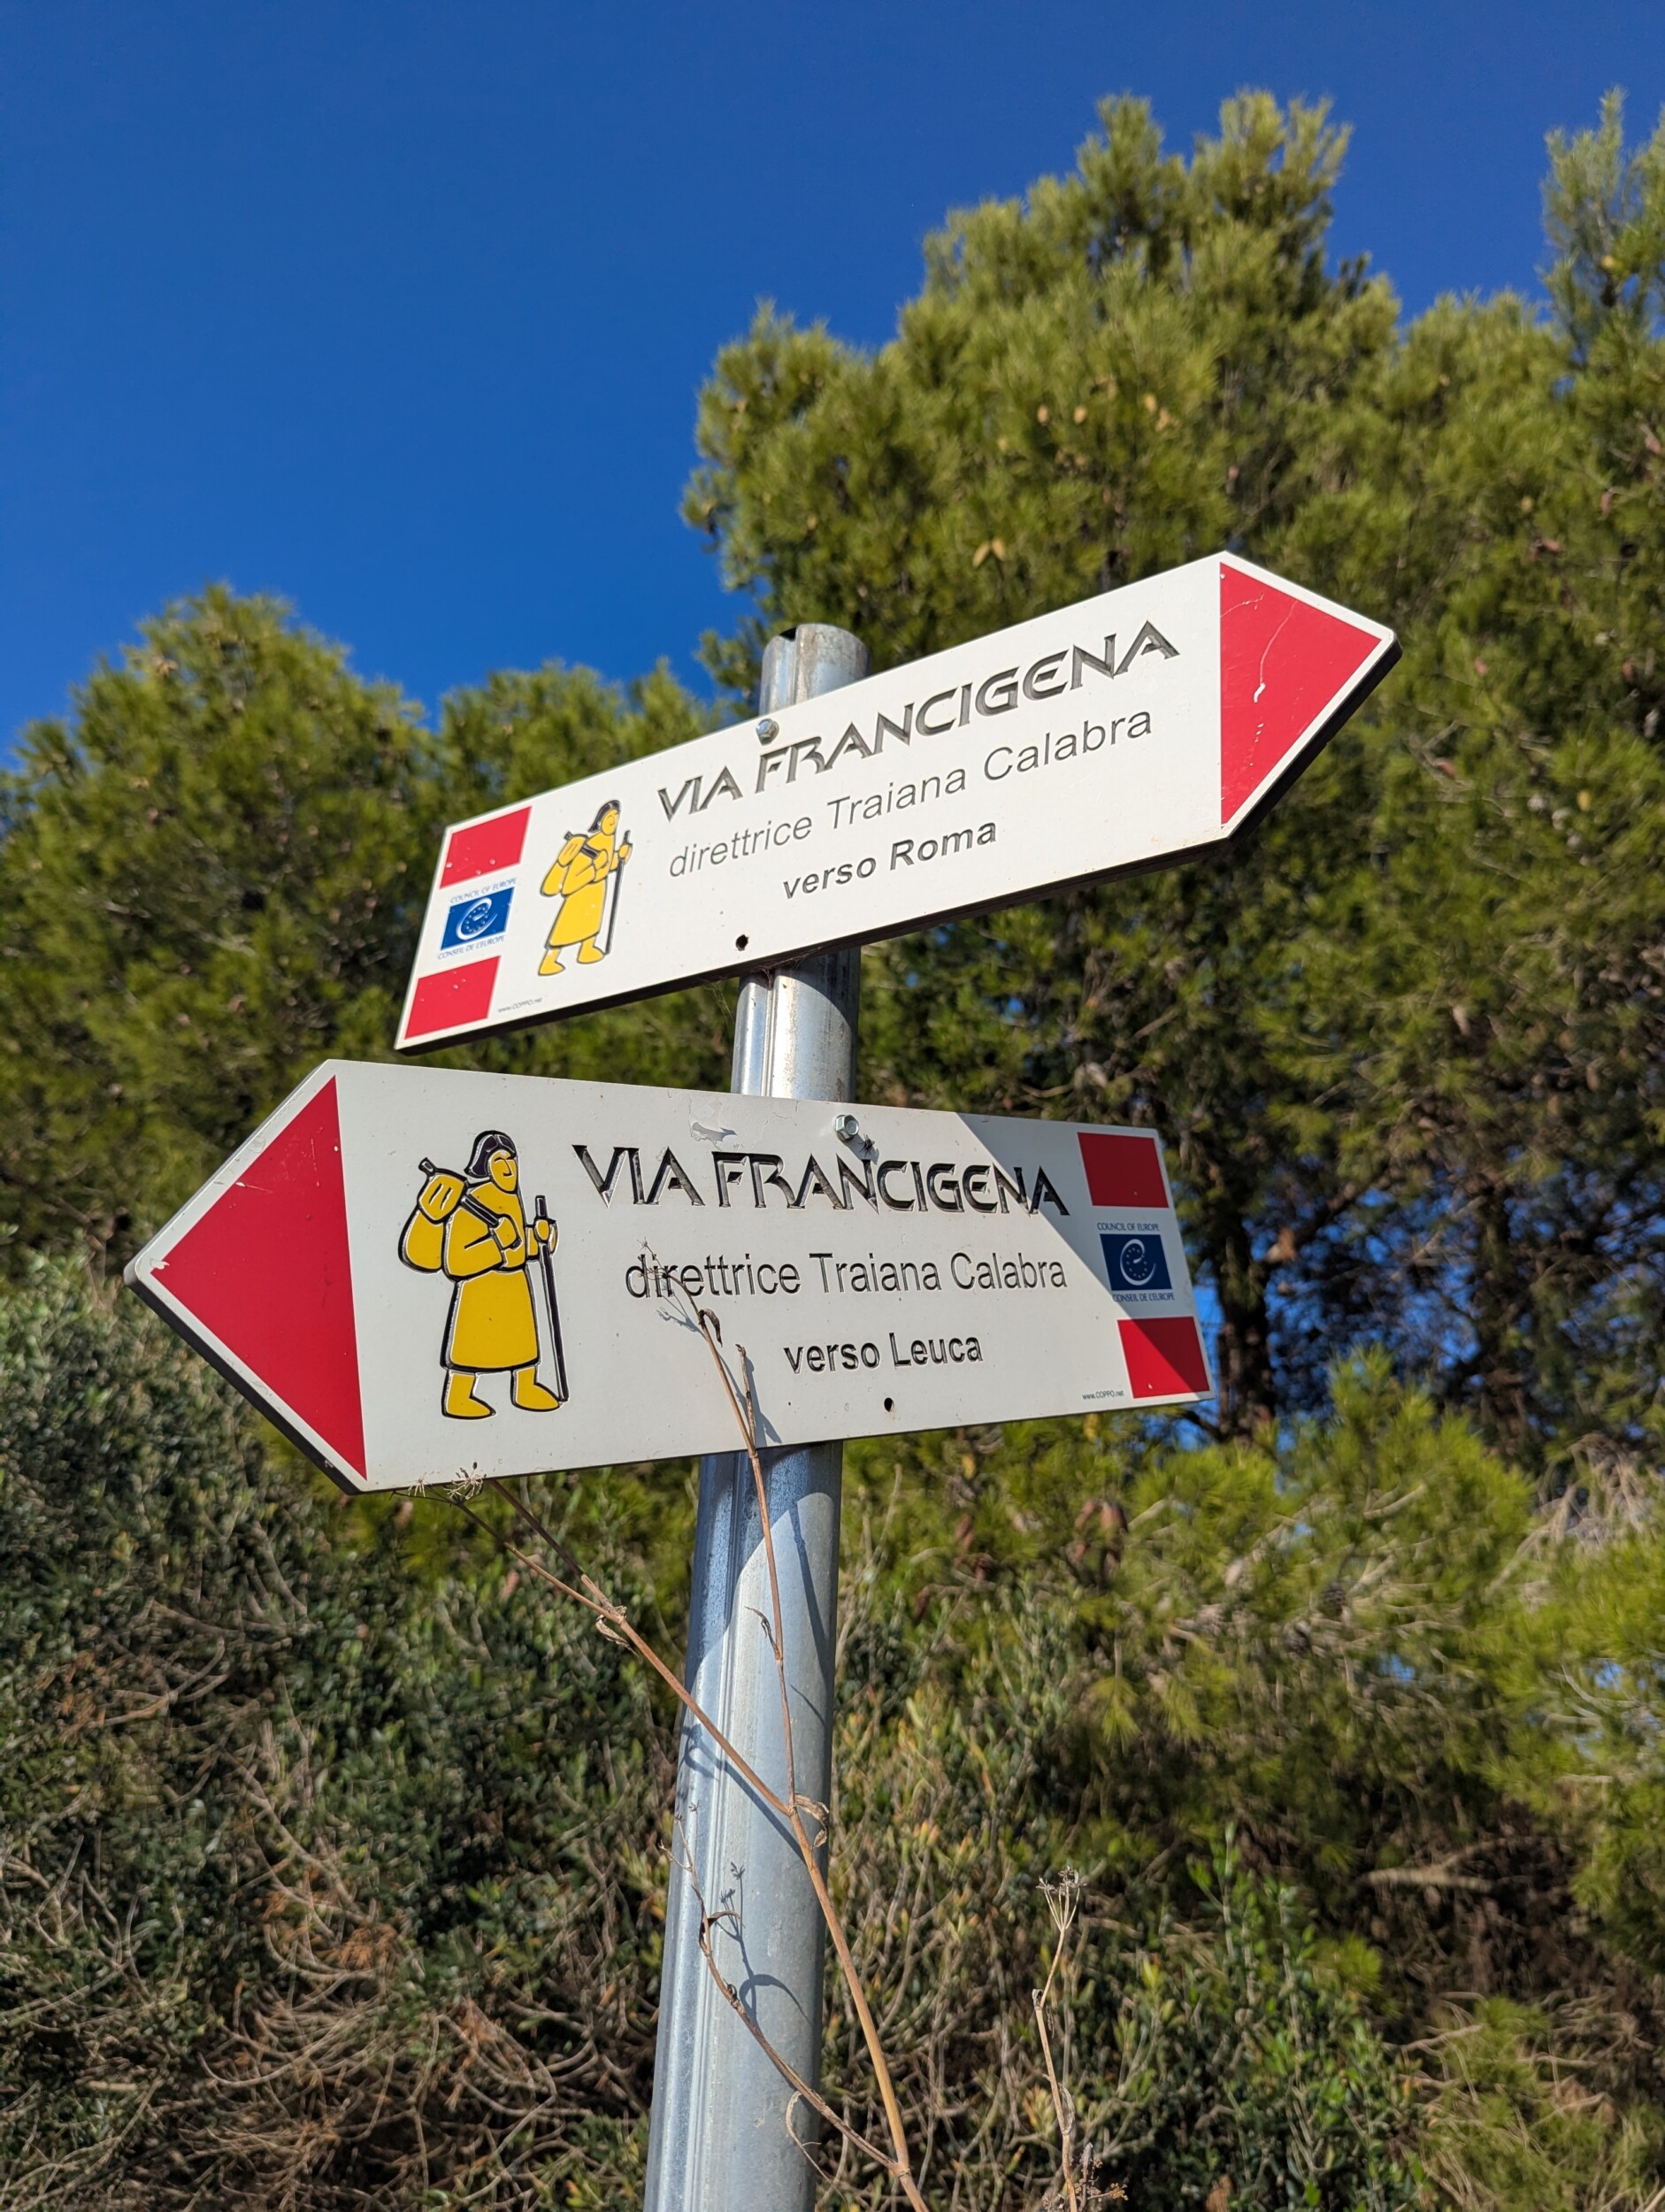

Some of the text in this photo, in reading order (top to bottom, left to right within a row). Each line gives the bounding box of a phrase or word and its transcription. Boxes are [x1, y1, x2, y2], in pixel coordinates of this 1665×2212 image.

[658, 620, 1180, 820] VIA FRANCIGENA
[670, 709, 1152, 878] direttrice Traiana Calabra
[783, 819, 996, 898] verso Roma
[450, 888, 480, 903] COUNCIL
[492, 878, 517, 891] EUROPE
[438, 948, 464, 959] CONSEIL
[574, 1145, 1069, 1214] VIA FRANCIGENA
[1137, 1223, 1159, 1232] EUROPE
[625, 1251, 1067, 1299] direttrice Traiana Calabra
[1112, 1293, 1138, 1302] CONSEIL
[1139, 1293, 1147, 1302] DE
[785, 1332, 982, 1374] verso Leuca
